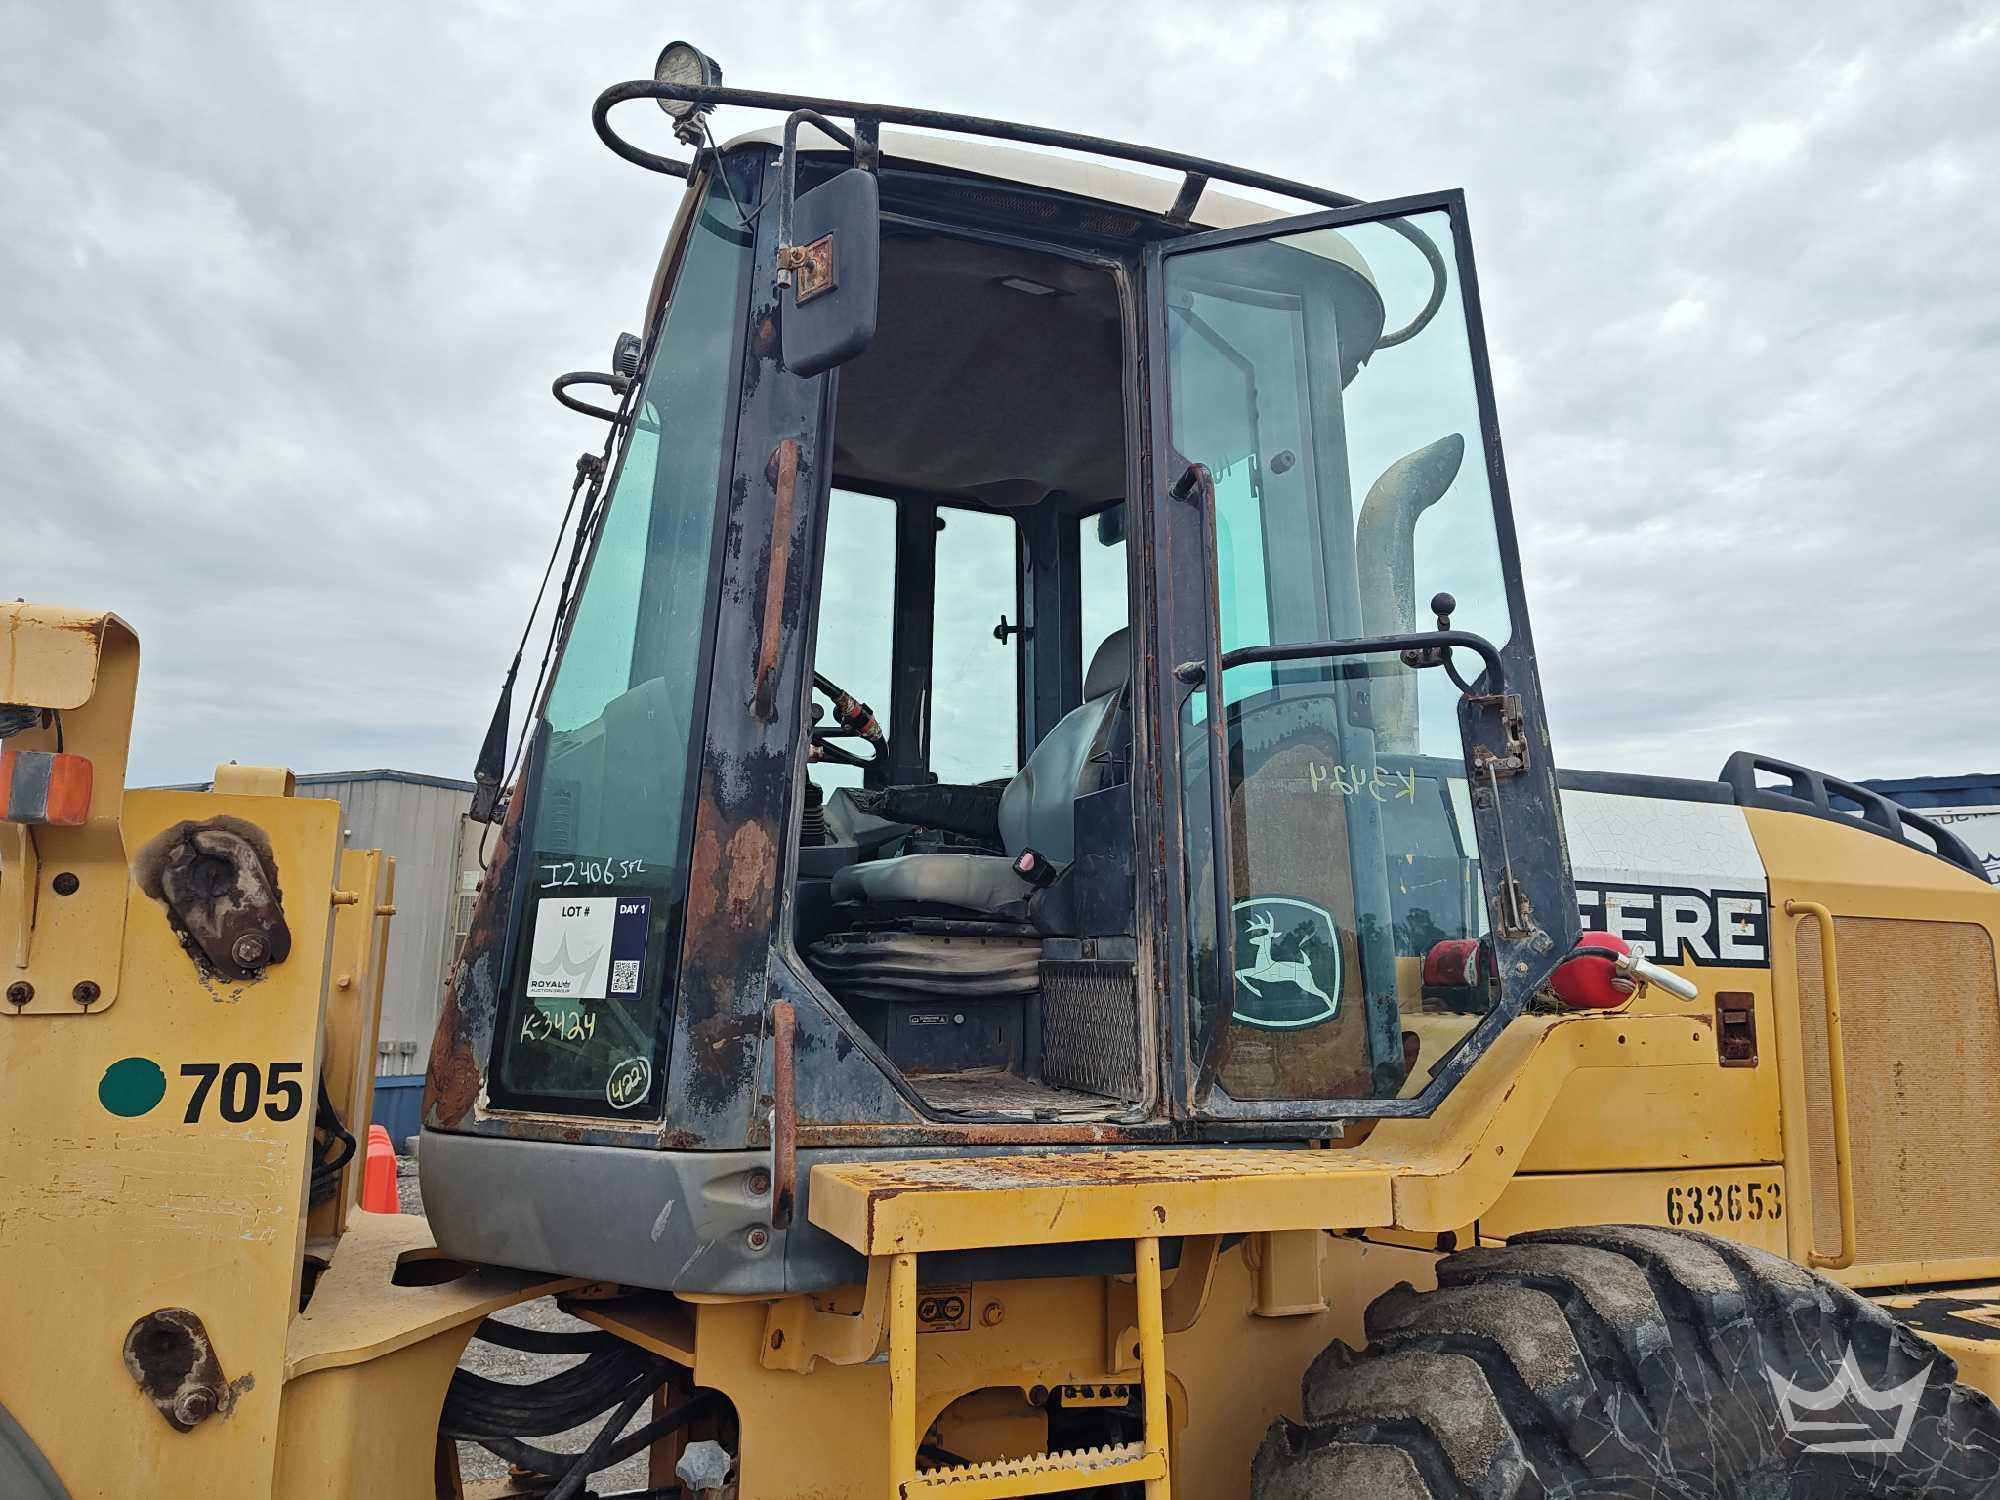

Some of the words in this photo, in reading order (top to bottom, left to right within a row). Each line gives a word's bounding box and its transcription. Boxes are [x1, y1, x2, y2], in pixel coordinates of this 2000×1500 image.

[561, 906, 582, 918] LOT
[583, 906, 591, 917] #
[619, 904, 639, 914] DAY
[639, 904, 646, 914] 1
[531, 980, 563, 988] ROYAL
[520, 1010, 597, 1044] K-3424
[180, 1062, 303, 1124] 705
[1666, 1183, 1782, 1225] 633653
